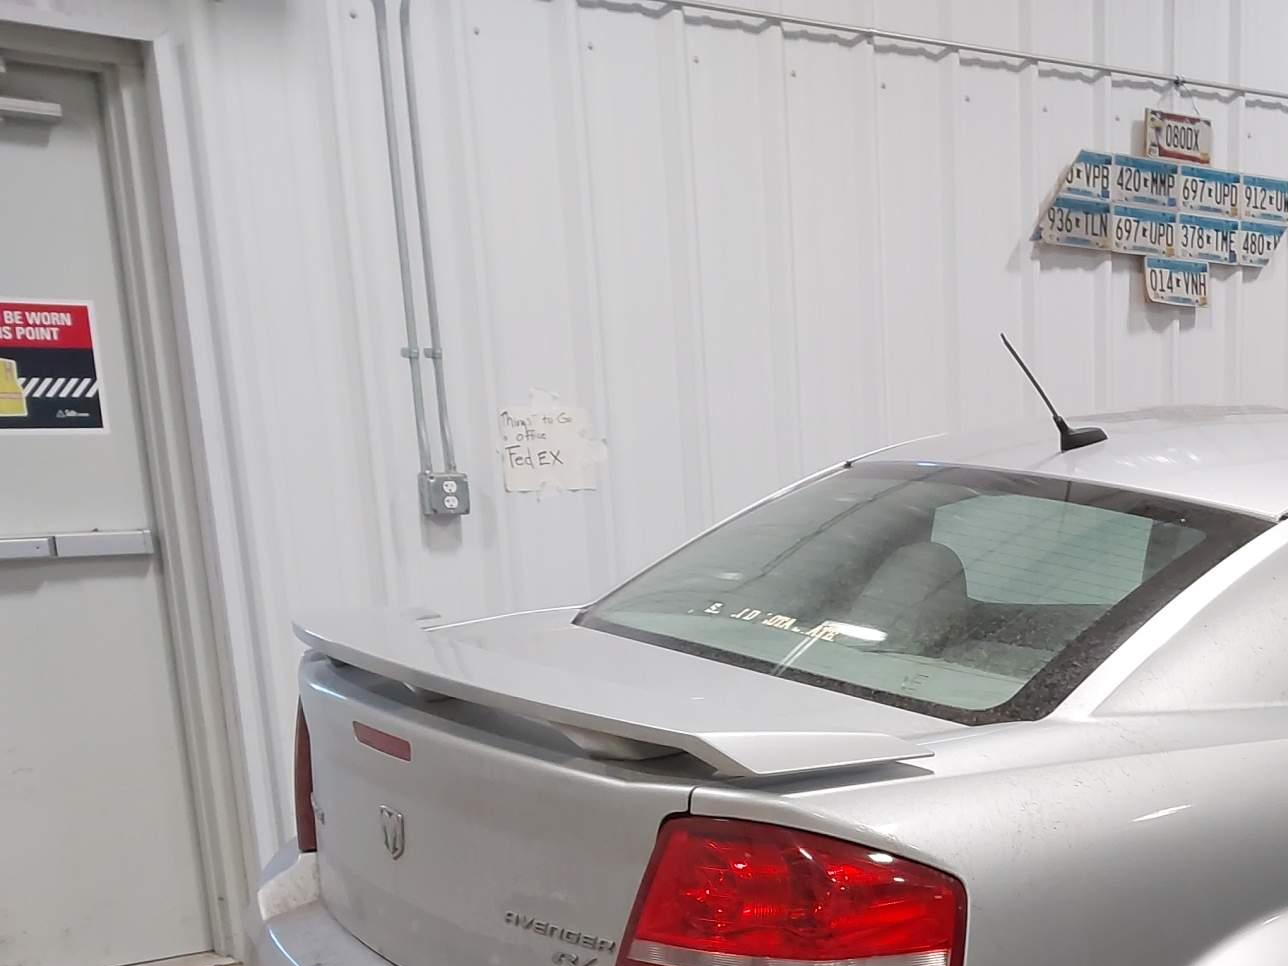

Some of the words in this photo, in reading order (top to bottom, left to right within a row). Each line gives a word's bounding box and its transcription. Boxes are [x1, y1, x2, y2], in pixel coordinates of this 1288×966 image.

[1117, 167, 1140, 192] 420
[1183, 178, 1205, 202] 697
[1245, 186, 1267, 210] 912
[1048, 207, 1073, 233] 936
[1116, 218, 1139, 242] 697
[1181, 225, 1204, 249] 378
[1243, 231, 1264, 255] 480
[1151, 269, 1173, 293] 014
[3, 310, 23, 324] BE
[25, 311, 72, 326] WORN
[15, 327, 60, 340] POINT
